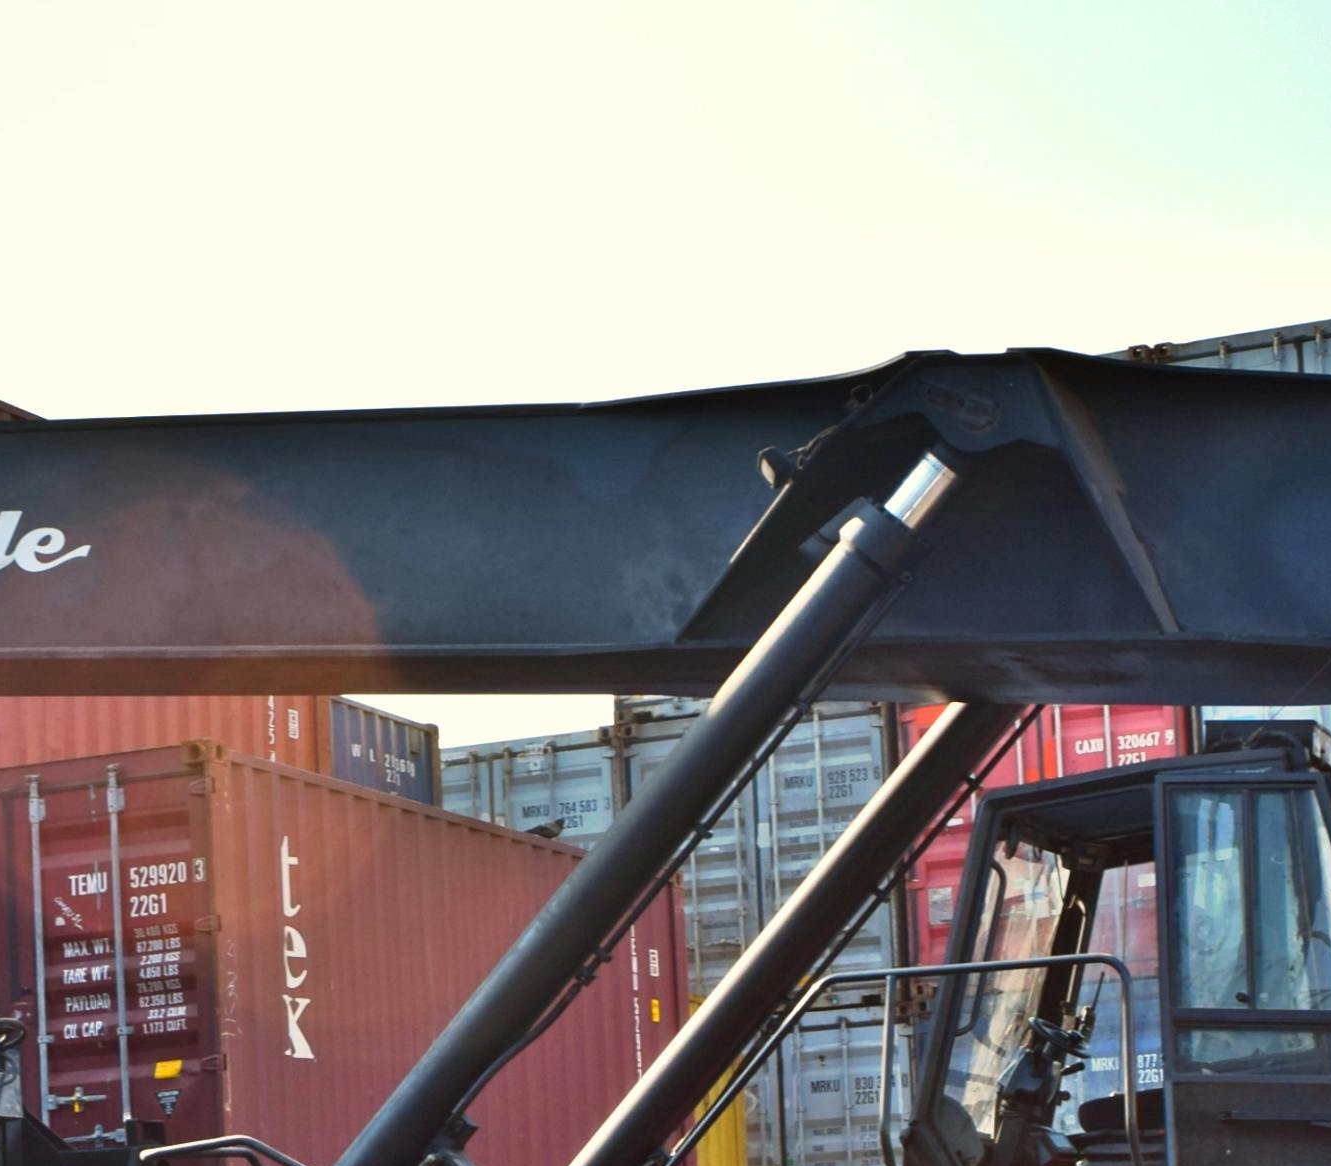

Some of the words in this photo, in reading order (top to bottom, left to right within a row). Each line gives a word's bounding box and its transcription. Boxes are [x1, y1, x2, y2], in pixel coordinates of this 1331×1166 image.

[1075, 738, 1104, 754] CAXU
[1117, 732, 1160, 750] 320667
[68, 872, 107, 896] TEMU
[130, 862, 187, 888] 529920
[195, 860, 204, 881] 3
[130, 893, 167, 917] 22G1
[166, 937, 181, 949] LBS
[281, 835, 315, 1059] tex
[63, 968, 87, 984] TARE
[164, 964, 179, 976] LBS
[65, 993, 111, 1013] PAYLOAD
[168, 992, 184, 1004] LBS
[811, 1080, 840, 1093] MRKU
